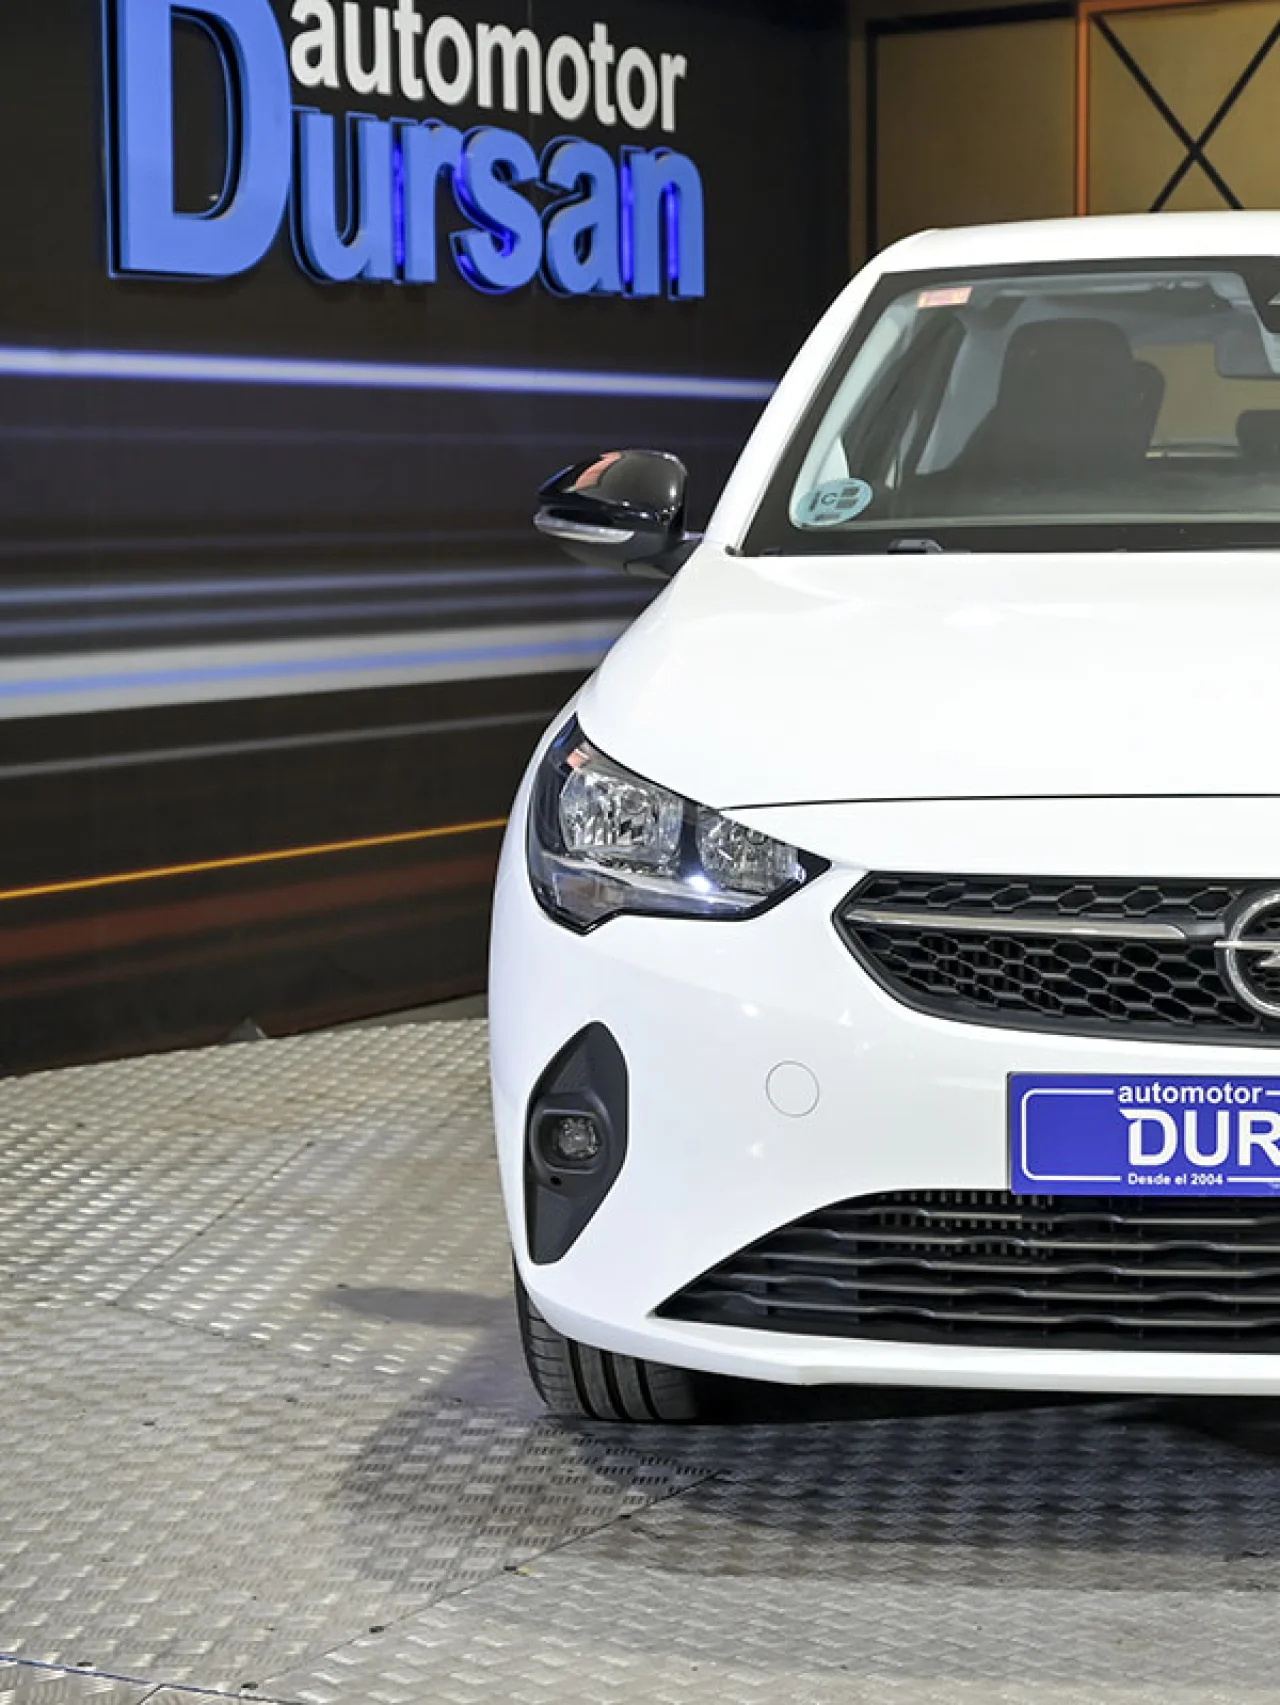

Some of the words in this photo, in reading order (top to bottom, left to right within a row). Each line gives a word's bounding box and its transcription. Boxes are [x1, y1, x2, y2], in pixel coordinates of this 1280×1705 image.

[289, 0, 687, 132] automotor
[102, 0, 705, 298] Dursan
[1118, 1082, 1263, 1104] automotor
[1128, 1173, 1171, 1185] Desde
[1175, 1173, 1187, 1185] el
[1190, 1173, 1224, 1185] 2004
